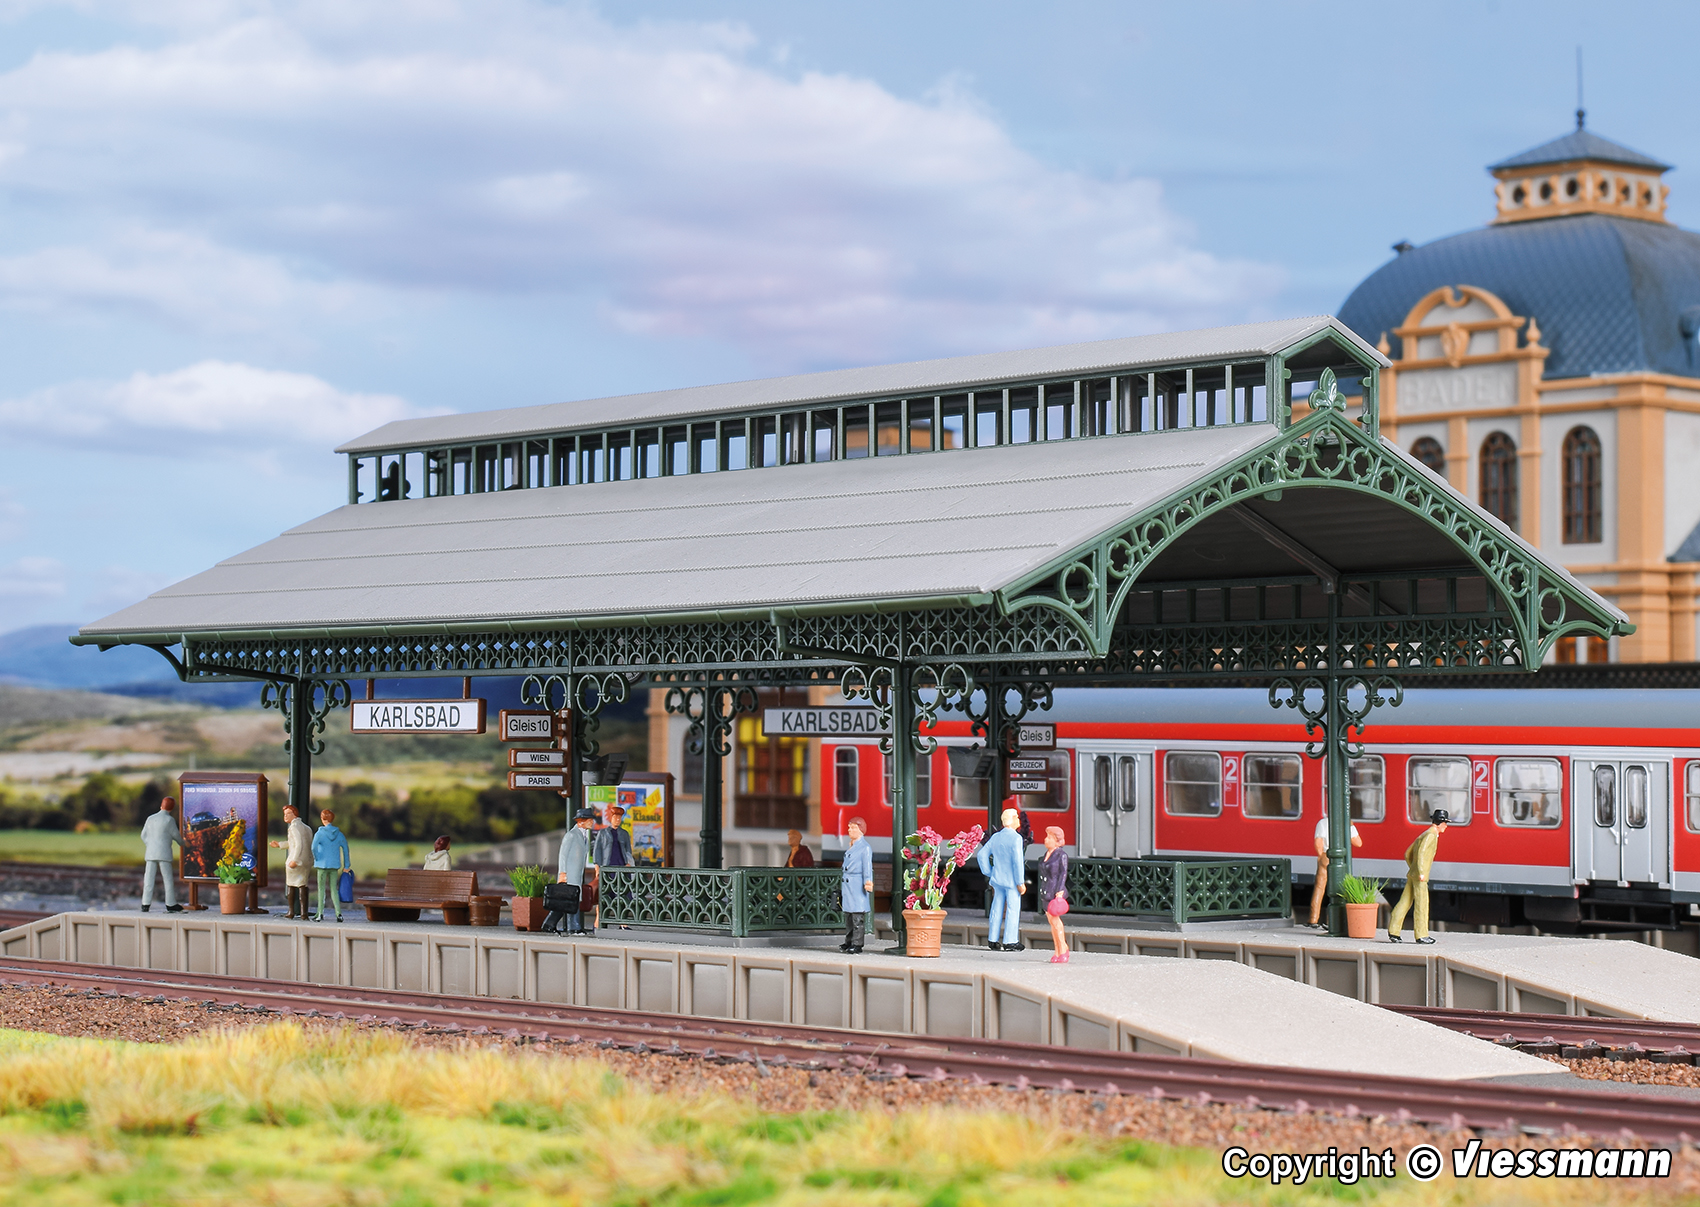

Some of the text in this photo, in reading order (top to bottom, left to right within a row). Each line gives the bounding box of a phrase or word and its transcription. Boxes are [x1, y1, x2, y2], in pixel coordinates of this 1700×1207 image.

[1402, 368, 1512, 410] BADEN
[370, 705, 461, 728] KARLSBAD
[782, 711, 878, 732] KARLSBAD
[1020, 729, 1052, 742] Gleis 9
[530, 754, 550, 762] WIEN
[1011, 761, 1044, 769] KREUZECK
[1225, 758, 1238, 781] 2
[528, 777, 551, 785] PARIS
[1475, 763, 1489, 787] 2
[1016, 782, 1039, 790] LINDAU
[633, 812, 662, 822] Klassik
